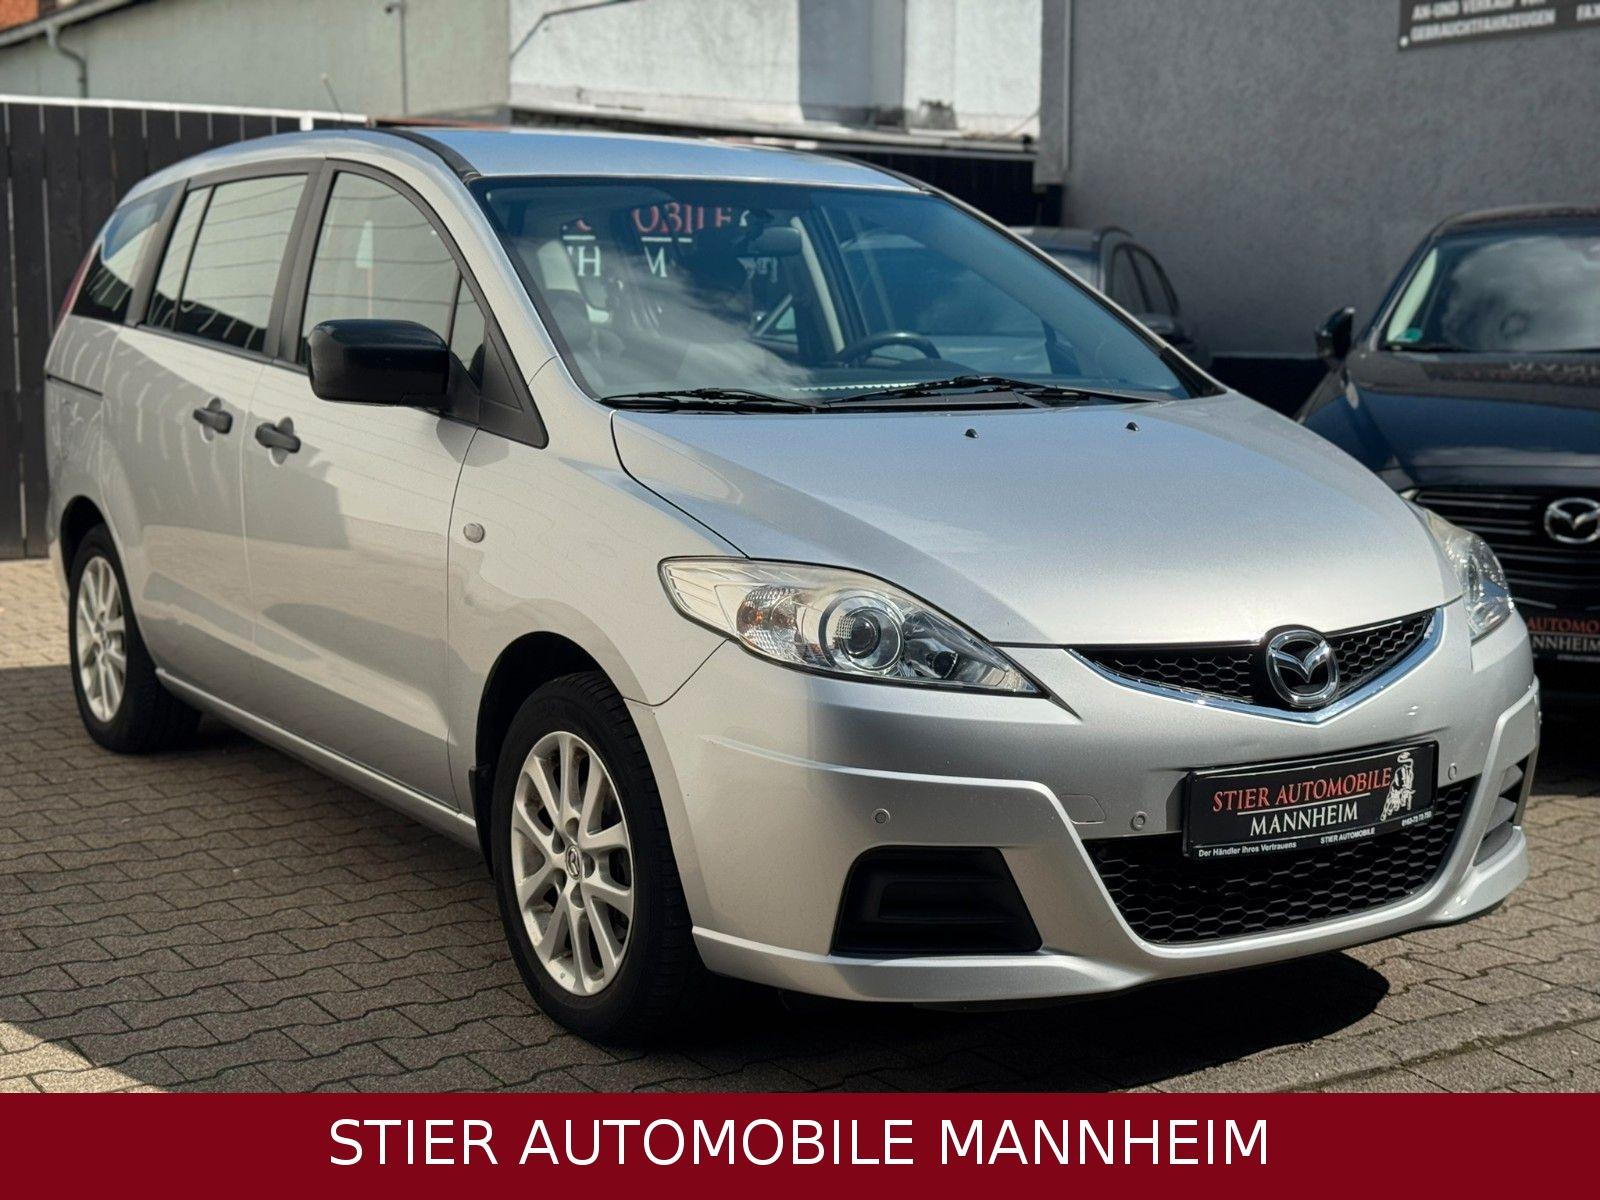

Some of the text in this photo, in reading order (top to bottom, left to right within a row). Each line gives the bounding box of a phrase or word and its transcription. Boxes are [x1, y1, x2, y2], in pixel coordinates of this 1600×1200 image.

[1212, 767, 1392, 812] STIER AUTOMOBILE
[1250, 802, 1358, 836] MANNHEIM
[1320, 827, 1376, 844] STIER AUTOMOBILE
[1198, 849, 1211, 857] Der
[1213, 846, 1241, 856] Händler
[1260, 842, 1297, 852] Vertrauens
